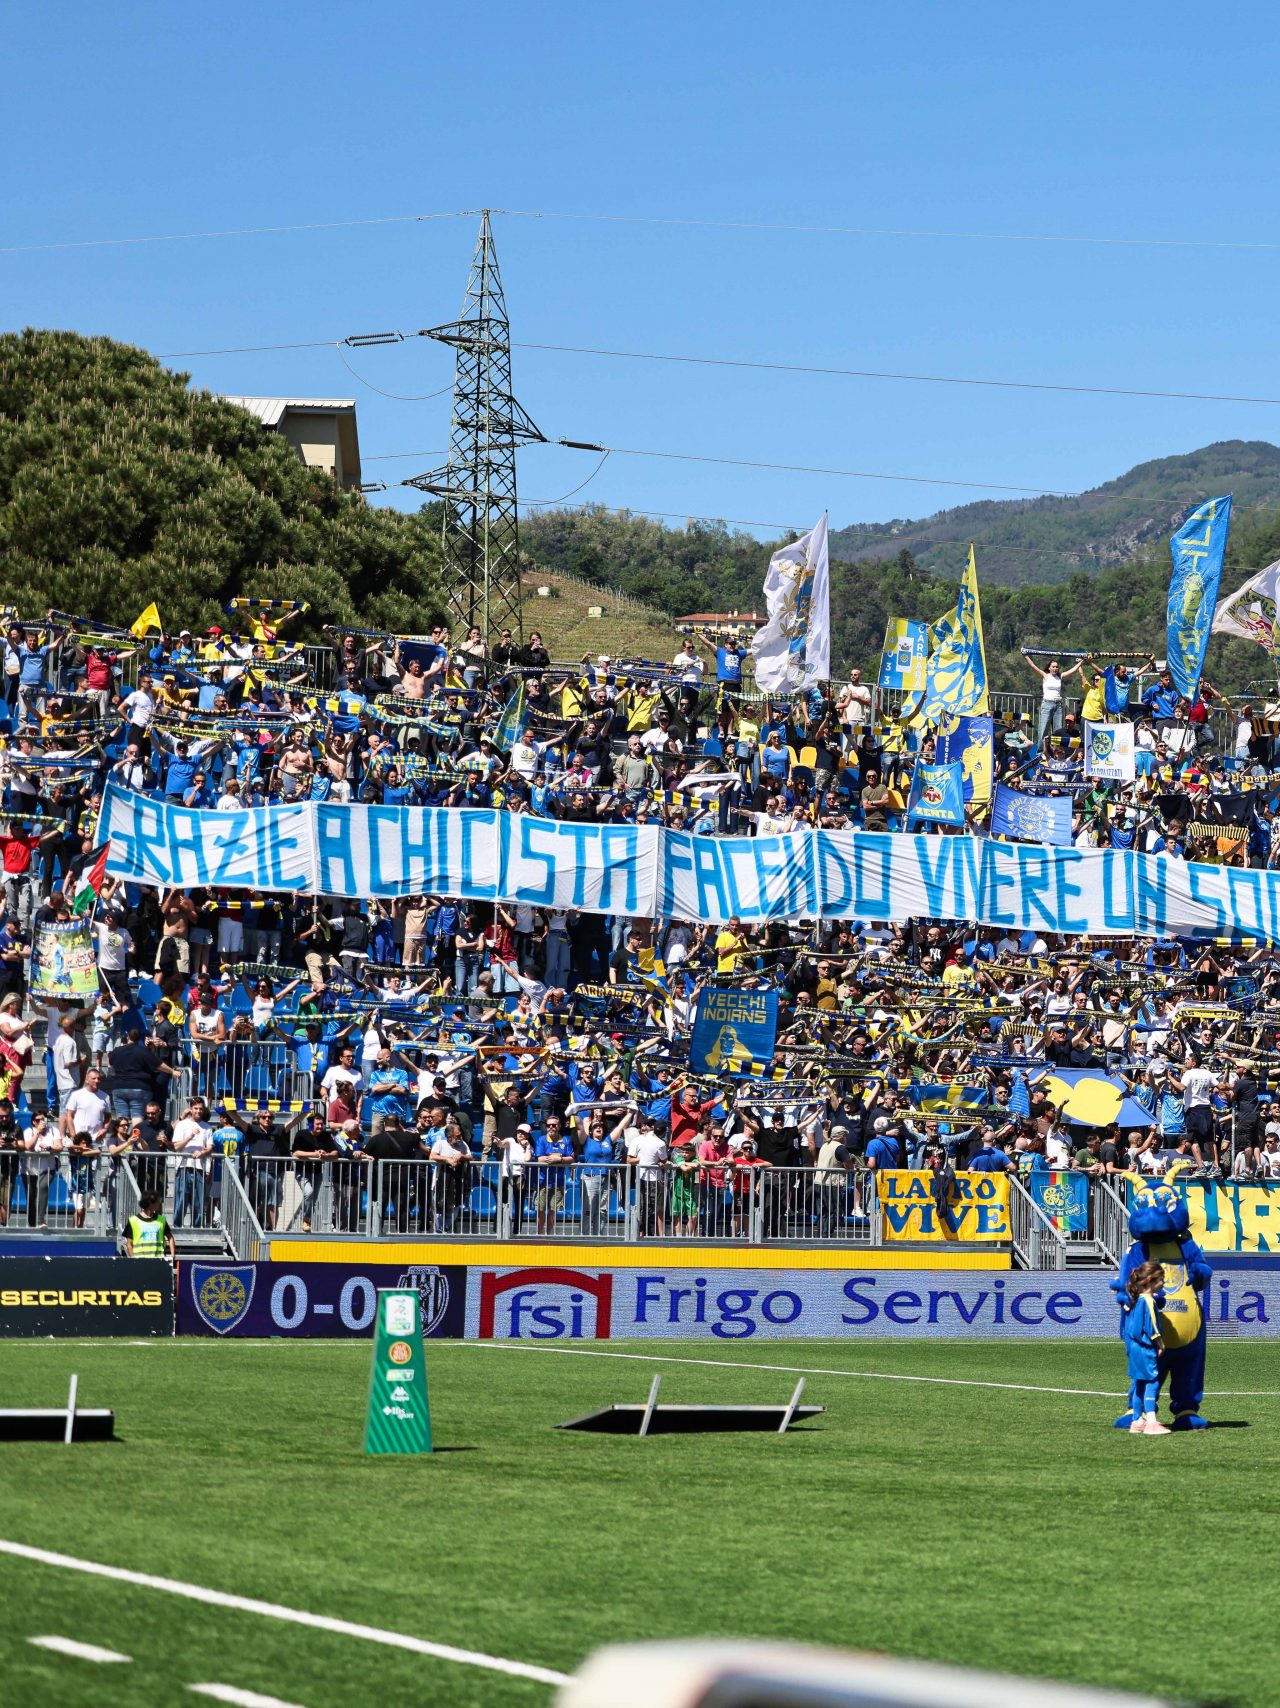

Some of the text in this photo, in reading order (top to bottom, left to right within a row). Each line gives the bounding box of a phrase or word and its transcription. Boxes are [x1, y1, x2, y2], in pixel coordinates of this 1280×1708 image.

[103, 784, 307, 891] GRAZIE
[317, 803, 357, 894] A
[368, 804, 448, 894] CHI
[516, 817, 638, 911] STA
[660, 828, 892, 919] FACENDO
[914, 836, 1088, 932] VIVERE
[1103, 851, 1167, 934] UN
[703, 1007, 767, 1024] INDIANS
[707, 992, 767, 1009] VECCHI
[886, 1177, 997, 1200] LARO
[883, 1203, 1007, 1234] VIVE
[0, 1290, 162, 1306] SECURITAS
[271, 1275, 378, 1330] 0-0
[635, 1277, 1269, 1339] Frigo Service lia
[508, 1290, 584, 1338] fsi
